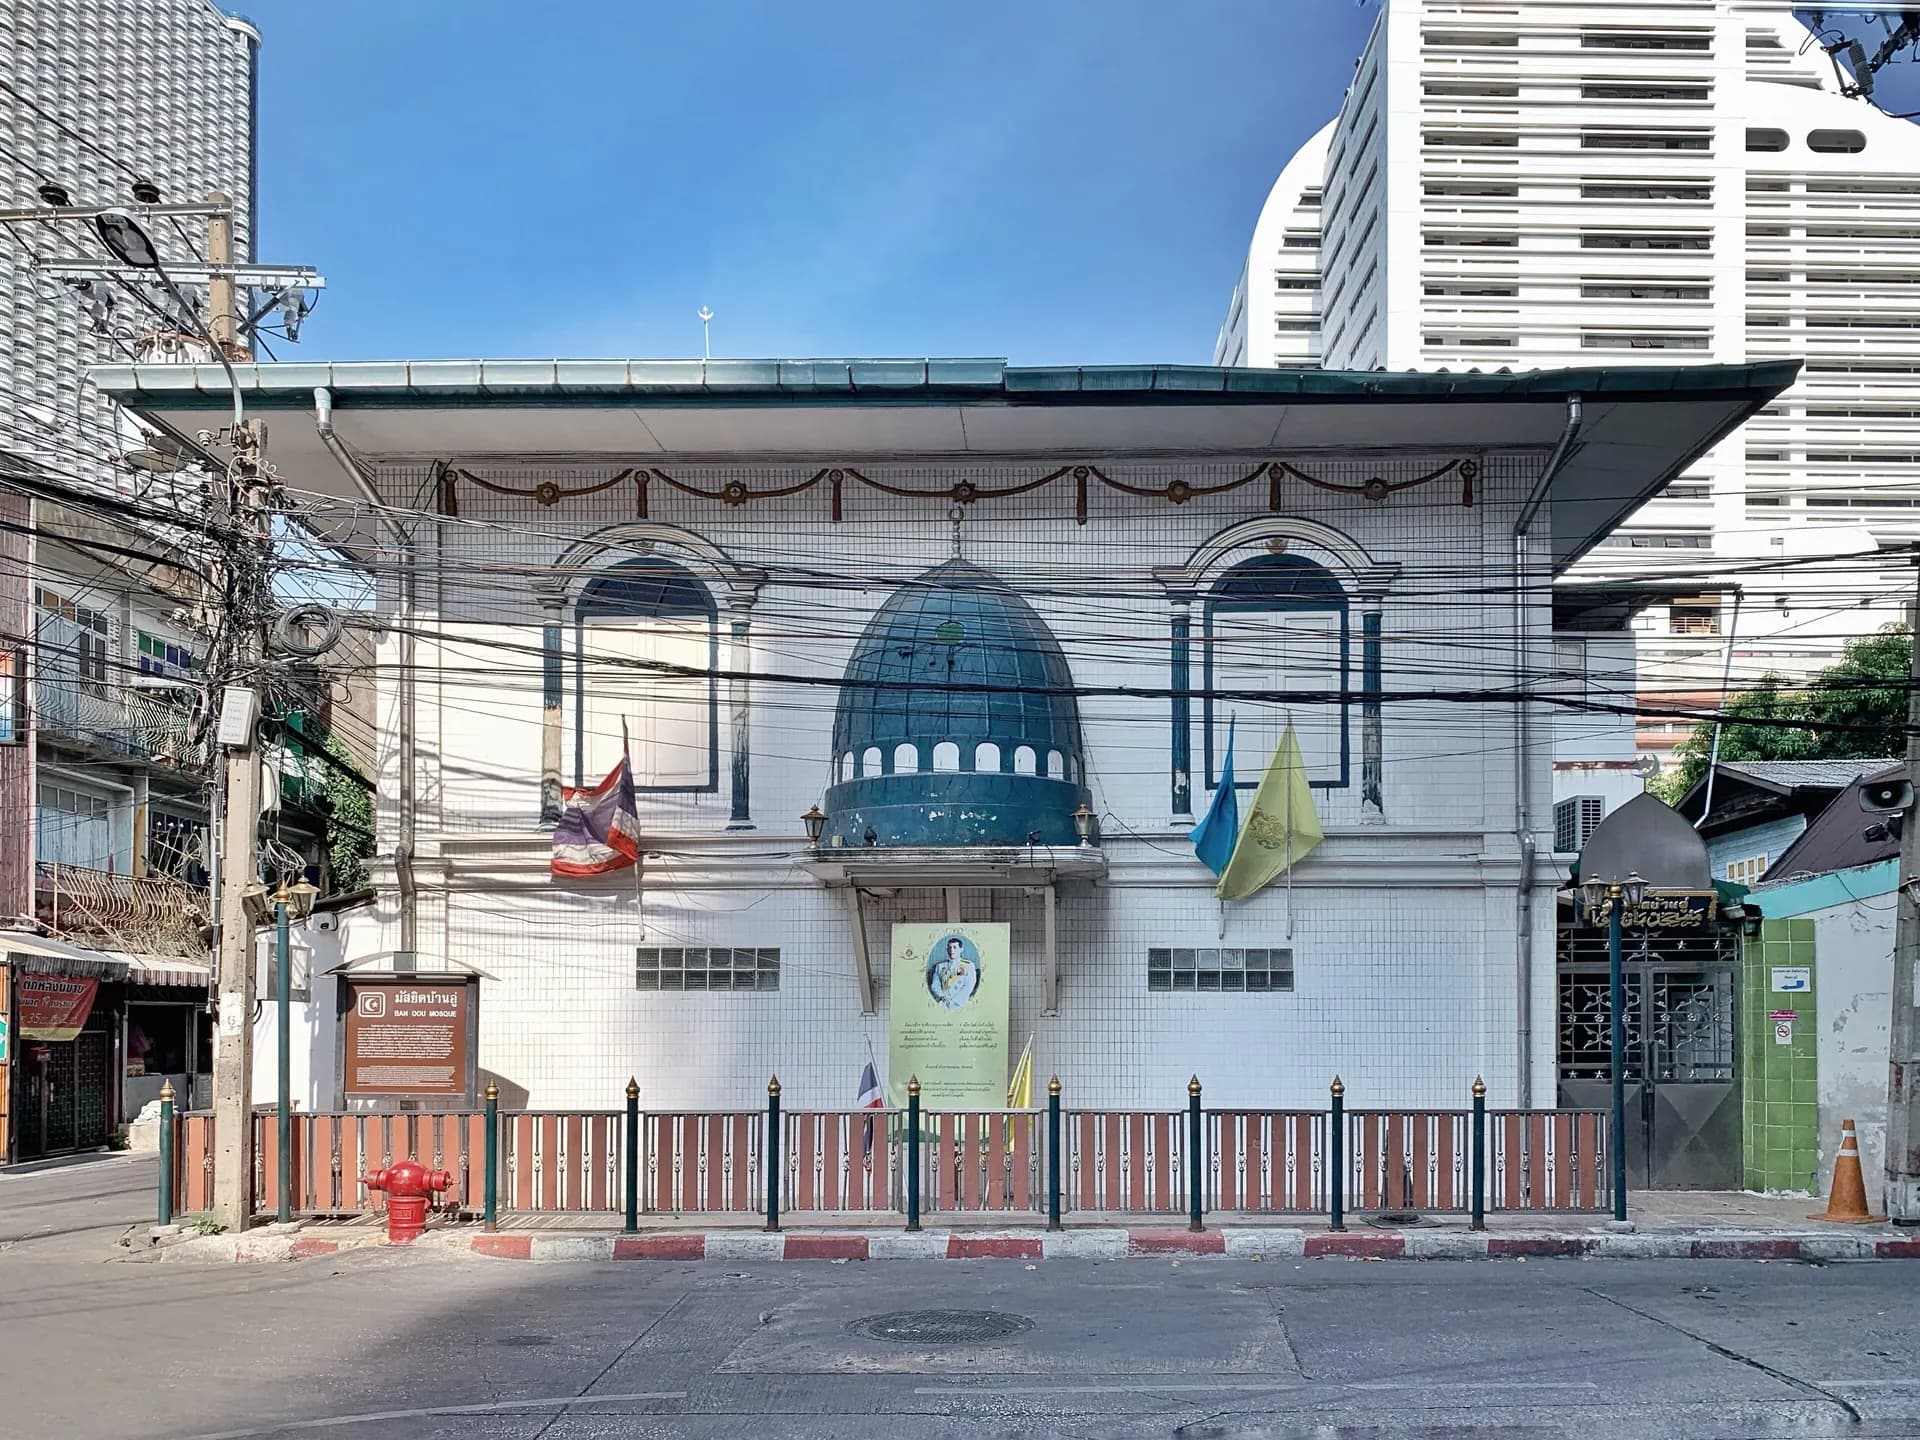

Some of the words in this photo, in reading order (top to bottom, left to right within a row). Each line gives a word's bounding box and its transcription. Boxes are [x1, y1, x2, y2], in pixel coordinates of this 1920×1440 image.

[394, 990, 458, 1007] มัสยิดบ้านอู่
